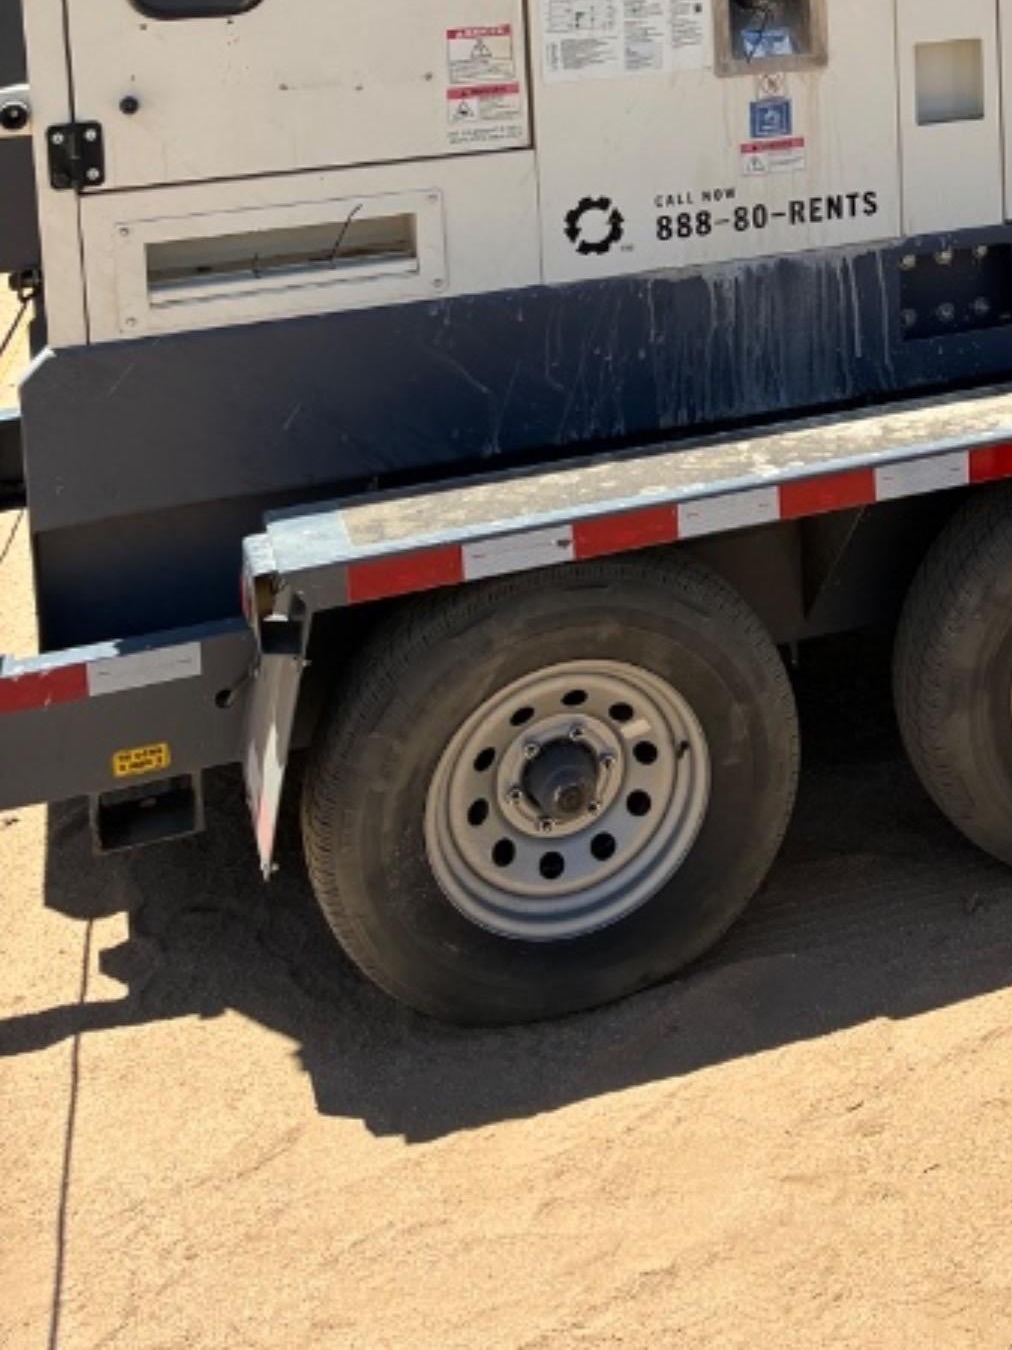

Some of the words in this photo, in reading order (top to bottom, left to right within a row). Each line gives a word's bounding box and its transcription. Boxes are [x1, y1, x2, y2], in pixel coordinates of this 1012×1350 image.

[654, 191, 694, 208] CALL
[701, 188, 736, 203] NOW
[656, 192, 878, 241] 888-80-RENTS
